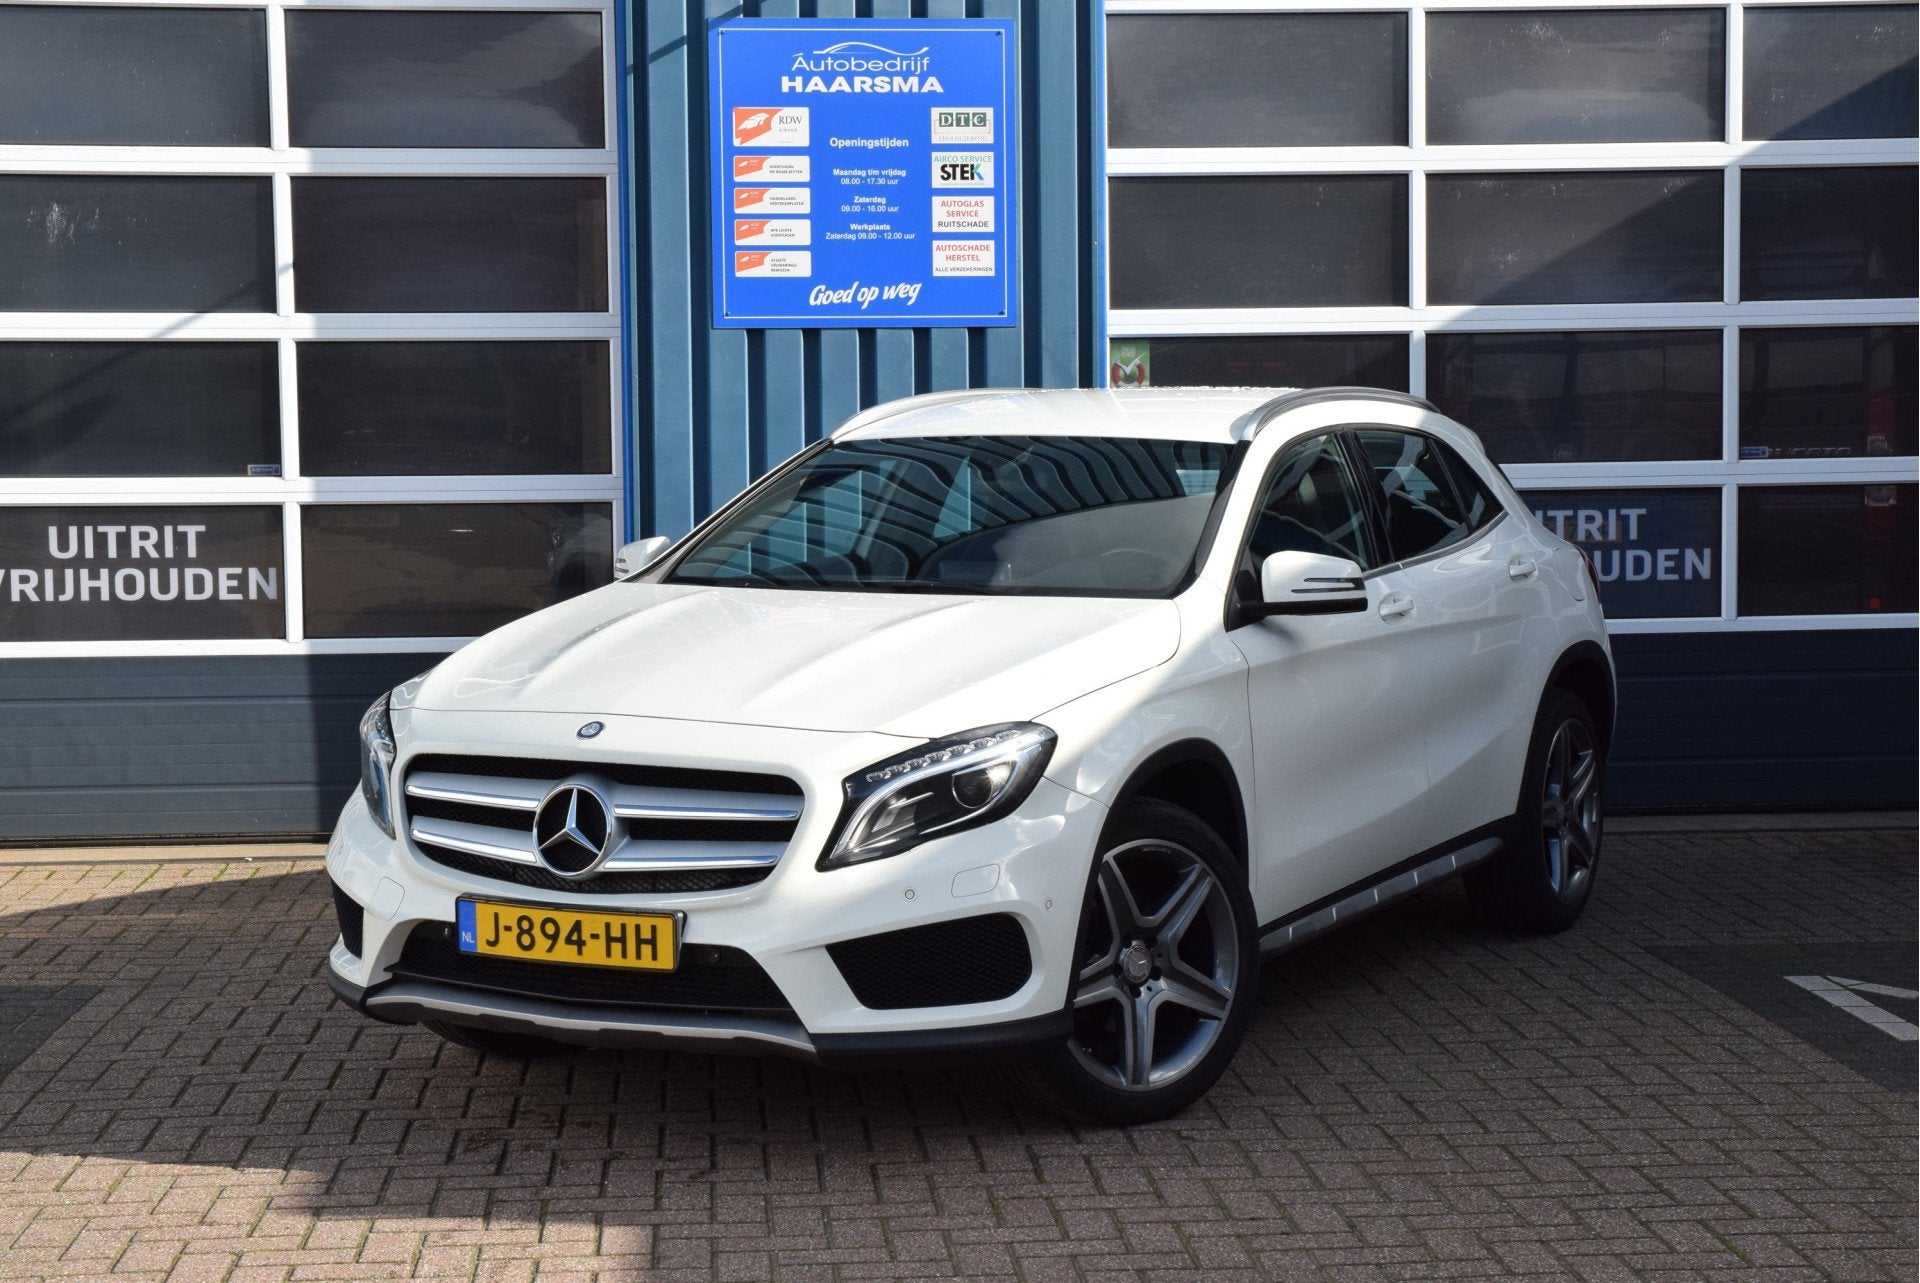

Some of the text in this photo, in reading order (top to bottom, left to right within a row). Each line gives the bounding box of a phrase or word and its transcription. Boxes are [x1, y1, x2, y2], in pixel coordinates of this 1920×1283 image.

[791, 55, 930, 75] Autobedrijf
[781, 76, 944, 93] HAARSMA
[778, 116, 803, 125] RDW
[940, 114, 985, 126] DTC
[829, 137, 909, 149] Openingstijden
[934, 155, 993, 163] AIRCO SERVICE
[833, 169, 867, 177] Maandag
[881, 169, 907, 177] vrijdag
[940, 163, 985, 181] STEK
[854, 196, 887, 204] Zaterdag
[941, 200, 985, 208] AUTOGLAS
[946, 210, 979, 218] SERVICE
[850, 223, 891, 231] Werkplaats
[825, 232, 856, 240] Zaterdag
[935, 244, 991, 252] AUTOSCHADE
[945, 254, 981, 262] HERSTEL
[809, 281, 922, 309] Goed op weg
[1535, 508, 1647, 541] TRIT
[48, 524, 207, 559] UITRIT
[461, 931, 475, 943] NL
[485, 912, 658, 961] J-894-HH
